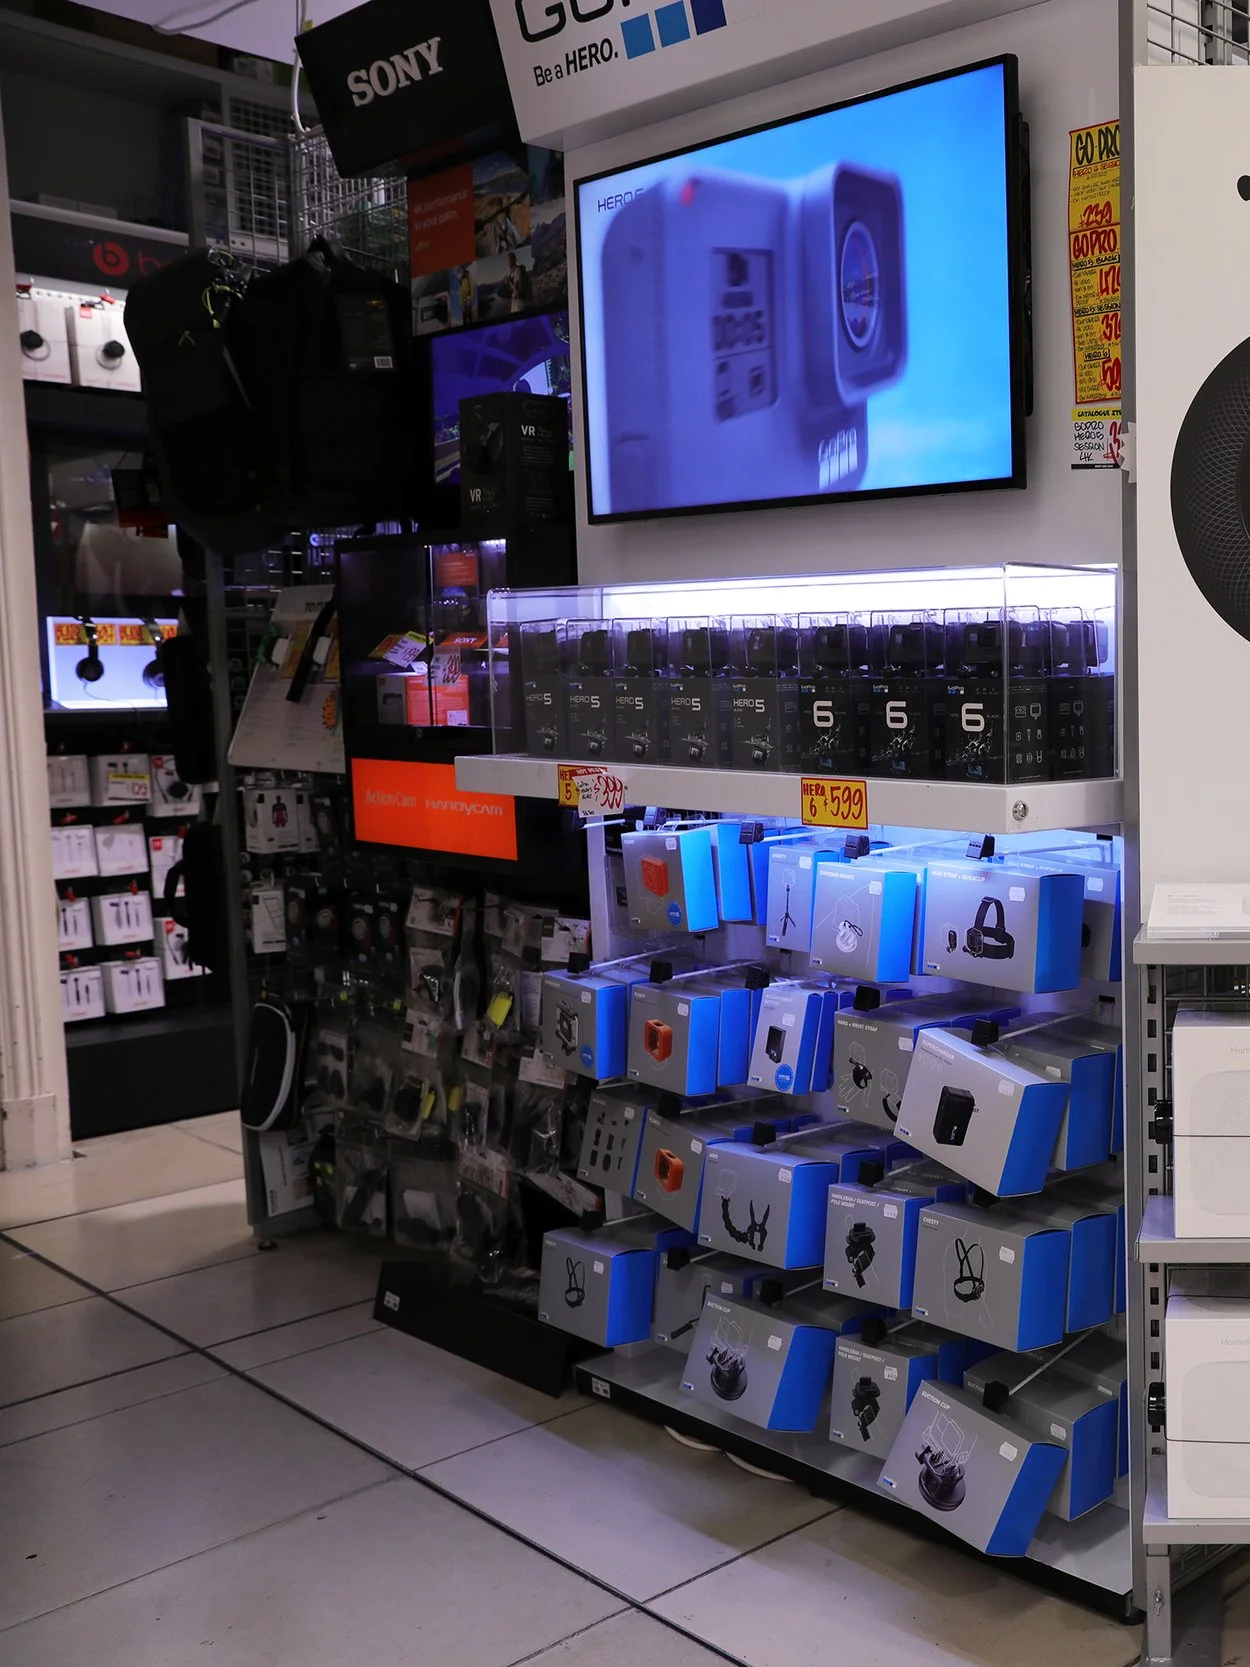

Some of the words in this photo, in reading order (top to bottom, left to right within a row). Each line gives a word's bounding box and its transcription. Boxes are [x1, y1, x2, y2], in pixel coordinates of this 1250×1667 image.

[533, 65, 553, 87] Be
[554, 65, 564, 80] a
[565, 38, 619, 76] HERO.
[346, 36, 444, 108] SONY
[1073, 228, 1118, 260] GOPRO
[1077, 410, 1111, 418] CATALOGUE
[520, 424, 536, 437] VR
[1073, 442, 1105, 451] SESSION
[469, 488, 482, 503] VR
[452, 636, 478, 645] SONY
[812, 699, 835, 728] 6
[885, 700, 909, 730] 6
[961, 702, 986, 733] 6
[802, 782, 826, 798] HERO
[808, 797, 818, 819] 6
[837, 1019, 848, 1027] HAND
[852, 1022, 865, 1030] WRIST
[865, 1024, 878, 1033] STRAP
[831, 1193, 854, 1203] HANDLEBAR
[856, 1199, 876, 1207] SEATPOST
[831, 1199, 842, 1207] POLE
[841, 1201, 855, 1209] MOUNT
[922, 1216, 940, 1226] CHESTY
[922, 1390, 941, 1406] SUCTION
[940, 1401, 951, 1410] CUP
